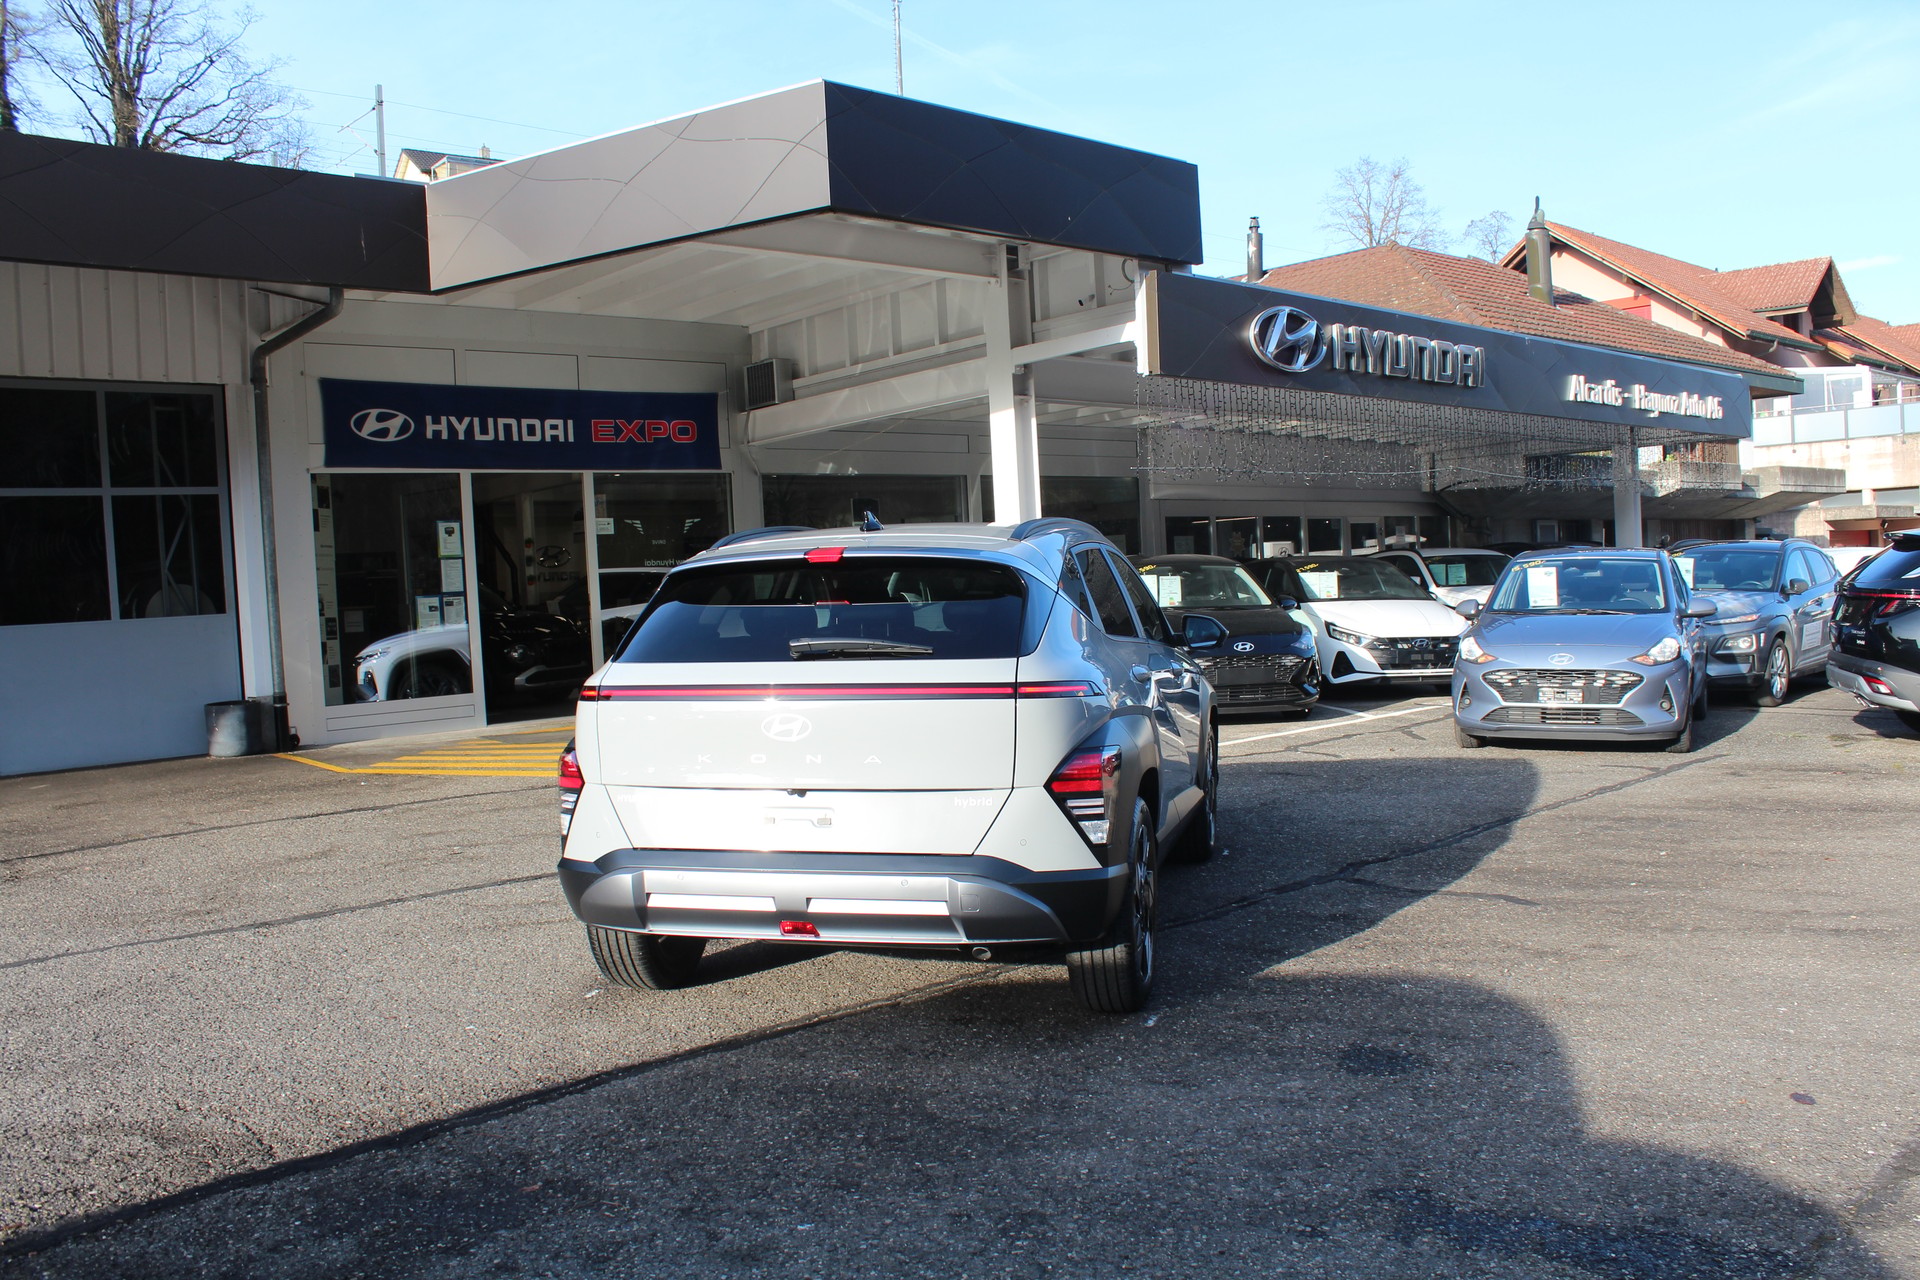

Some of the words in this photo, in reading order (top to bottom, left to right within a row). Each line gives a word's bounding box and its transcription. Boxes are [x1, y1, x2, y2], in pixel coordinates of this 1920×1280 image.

[1331, 323, 1486, 388] HYUNDAI
[425, 414, 575, 443] HYUNDAI
[591, 419, 698, 444] EXPO
[697, 753, 882, 765] KONA
[954, 796, 993, 808] hybrid
